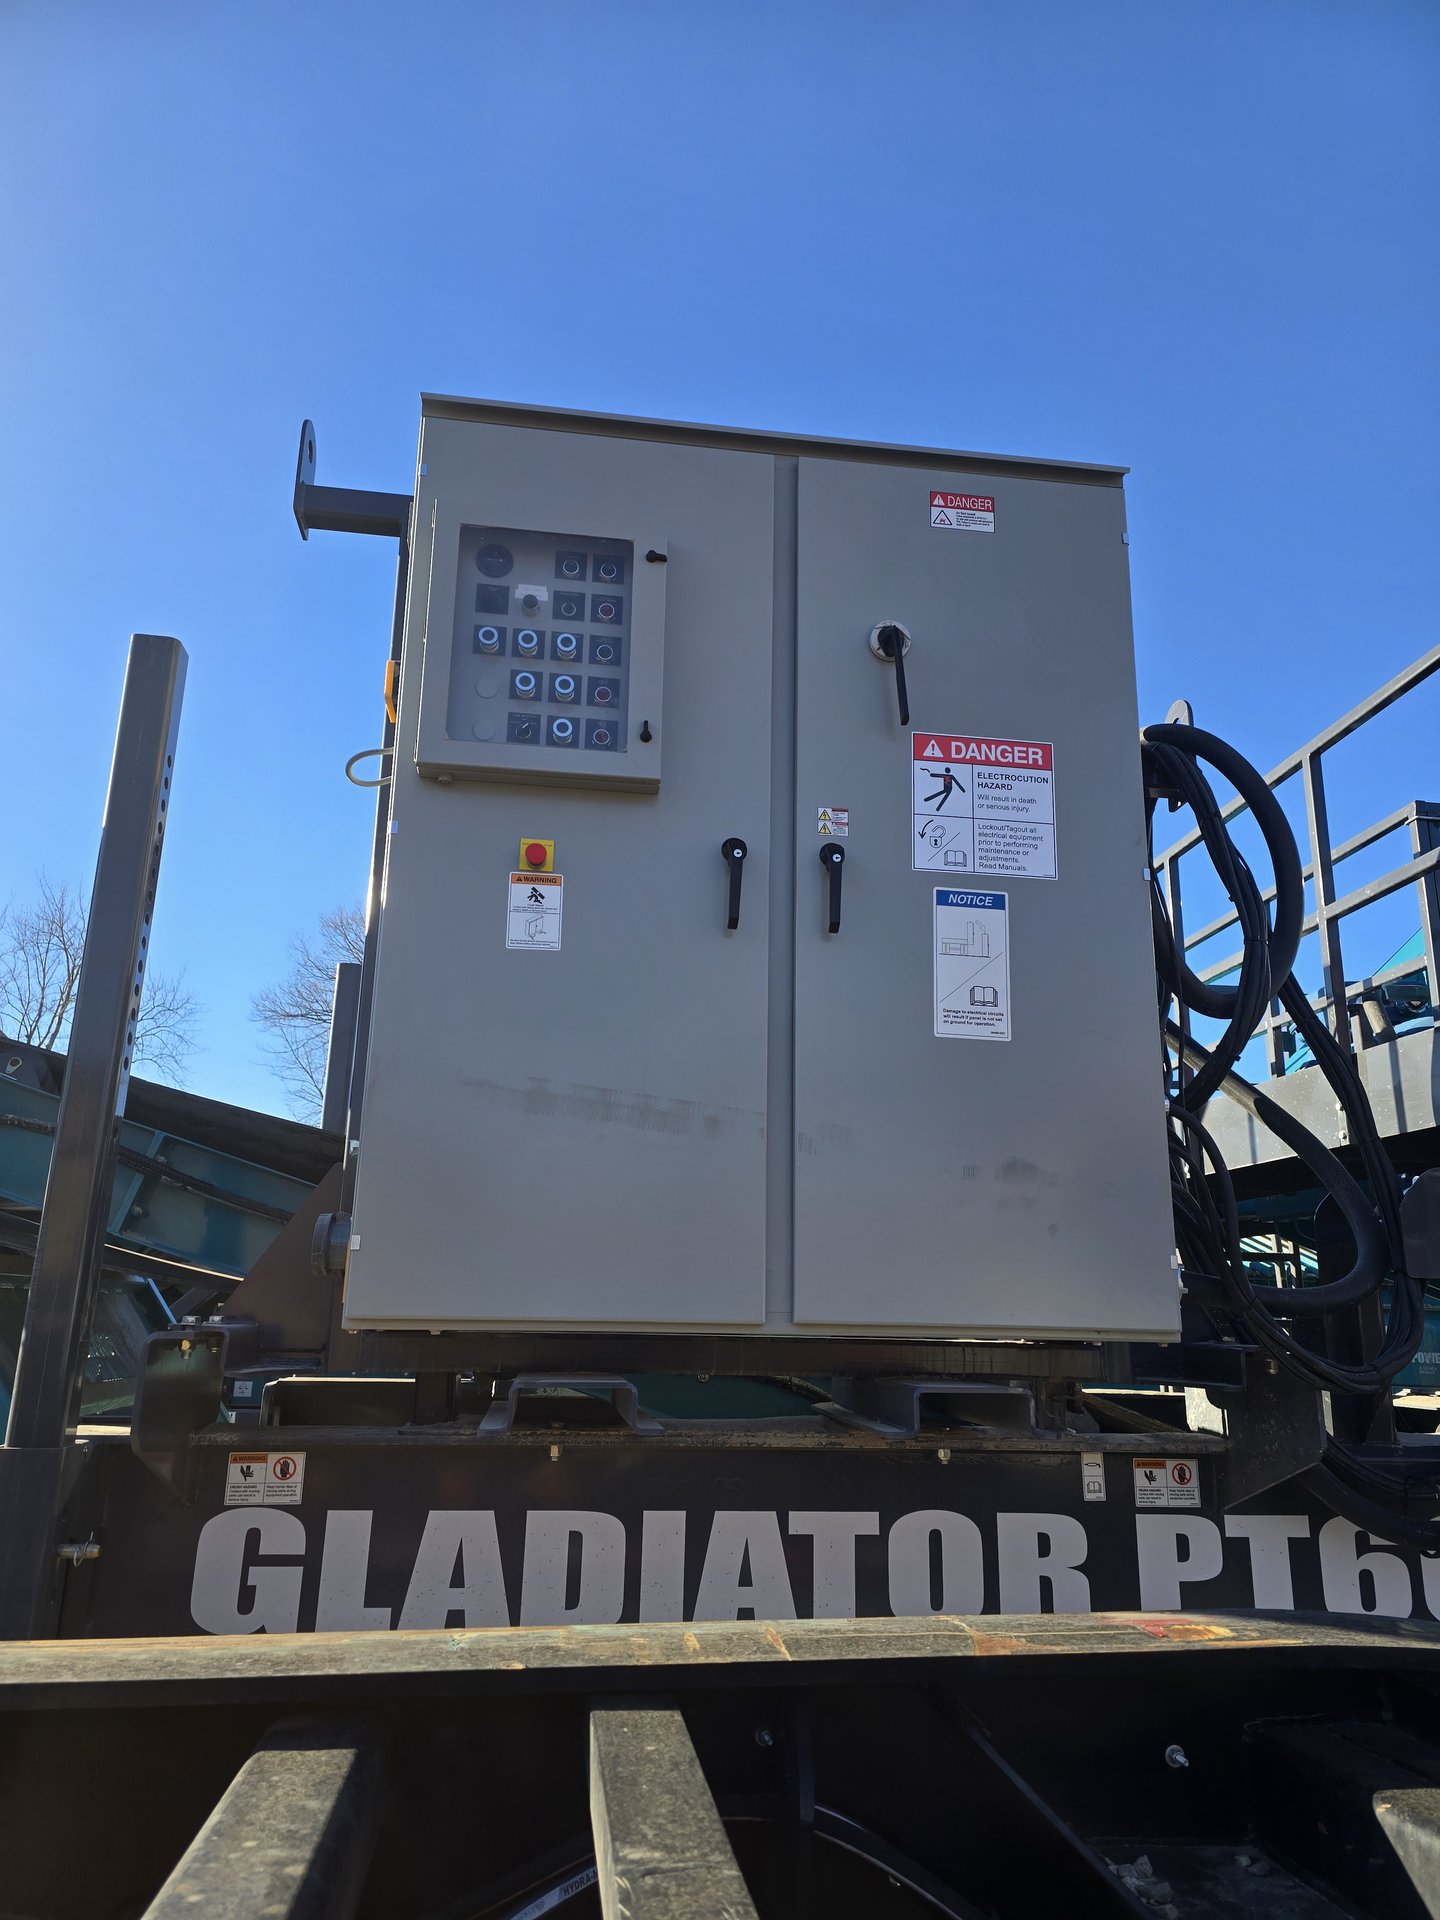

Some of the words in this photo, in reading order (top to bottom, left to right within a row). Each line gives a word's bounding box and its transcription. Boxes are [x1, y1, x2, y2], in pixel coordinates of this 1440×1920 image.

[947, 495, 992, 510] DANGER
[951, 741, 1043, 765] DANGER
[977, 772, 1049, 784] ELECTROCUTION
[977, 781, 1013, 791] HAZARD
[1011, 805, 1031, 813] injury.
[978, 824, 1028, 834] Lockout/Tagout
[978, 831, 1008, 839] electrical
[1009, 834, 1043, 842] equipment
[1003, 841, 1038, 850] performing
[978, 847, 1021, 856] maintenance
[978, 855, 1020, 864] adjustments.
[978, 862, 997, 870] Read
[998, 863, 1028, 872] Manuals.
[523, 876, 557, 884] WARNING
[948, 894, 994, 906] NOTICE
[190, 1507, 1091, 1634] GLADIATOR
